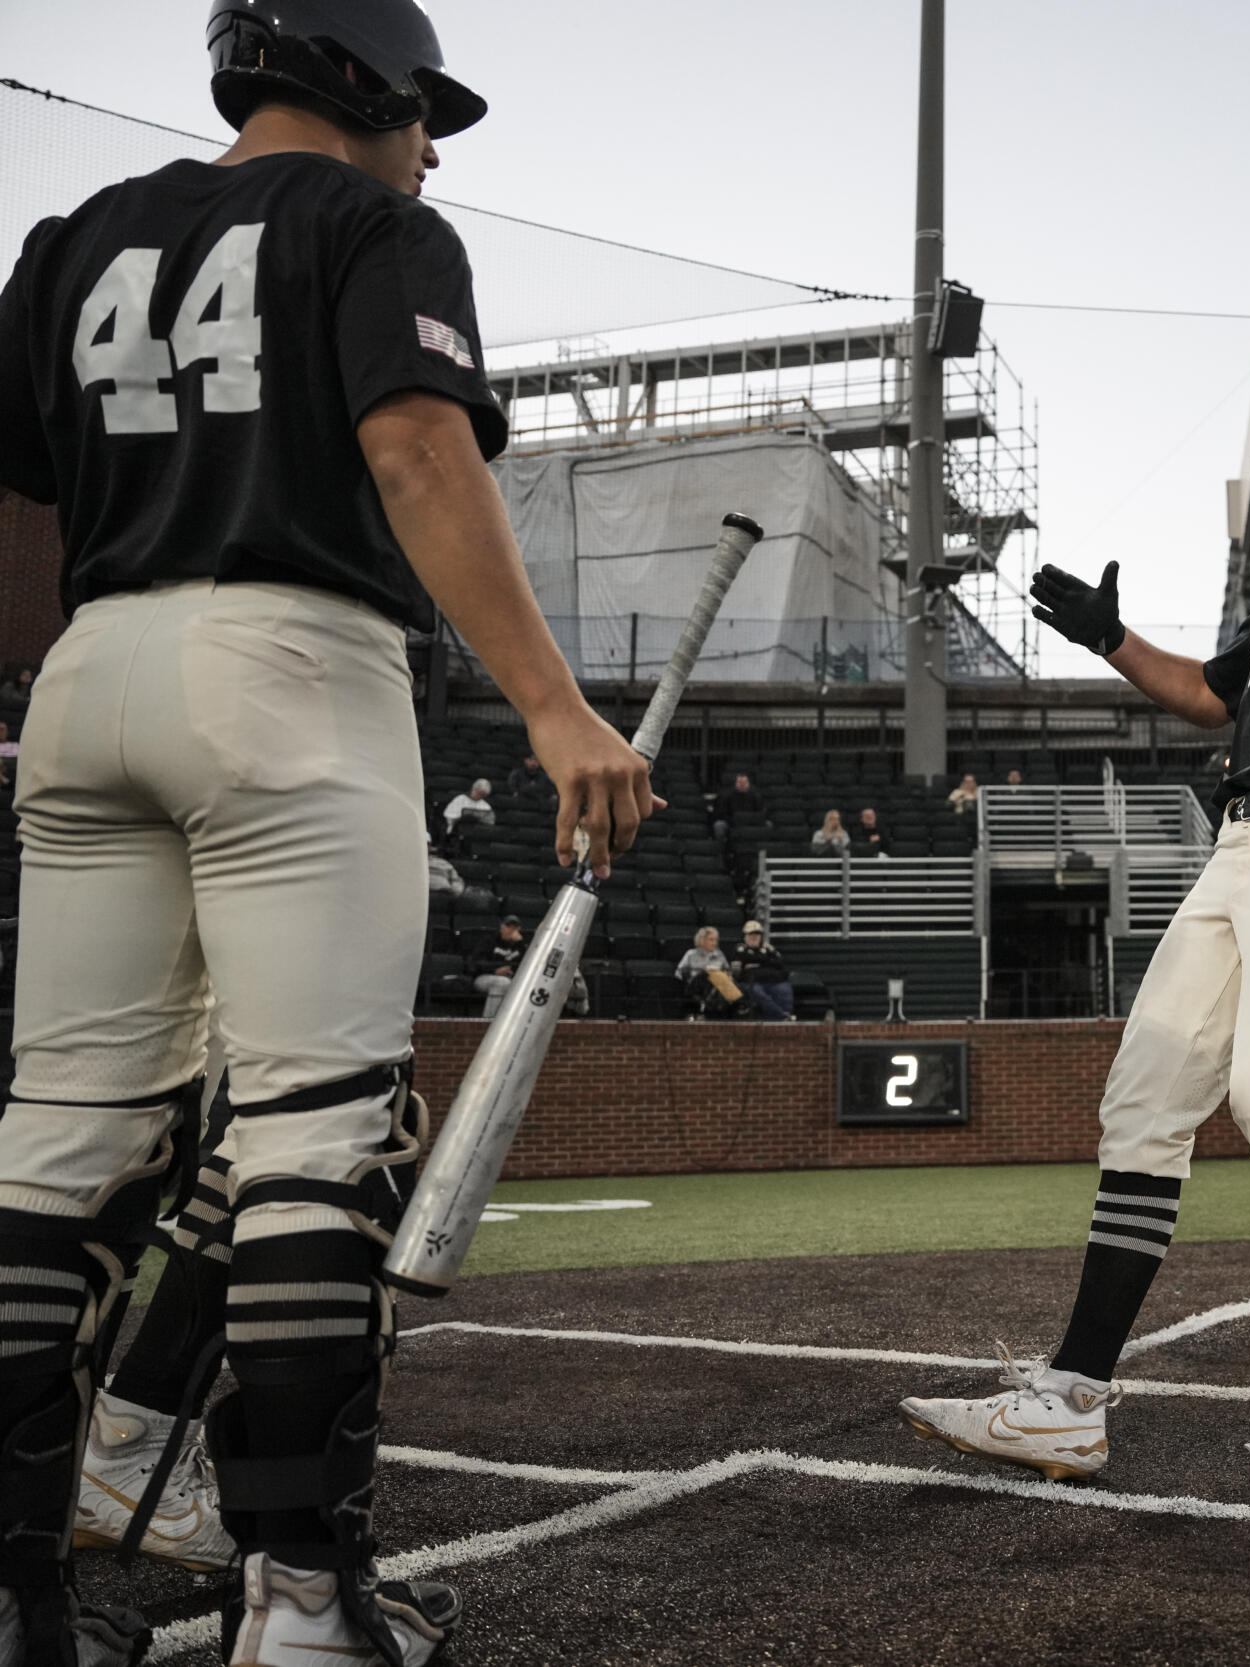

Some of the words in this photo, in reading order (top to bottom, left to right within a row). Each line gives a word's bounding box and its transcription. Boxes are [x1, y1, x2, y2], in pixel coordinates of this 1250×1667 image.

[72, 222, 266, 435] 44
[885, 1054, 918, 1107] 2
[1081, 1393, 1097, 1409] V
